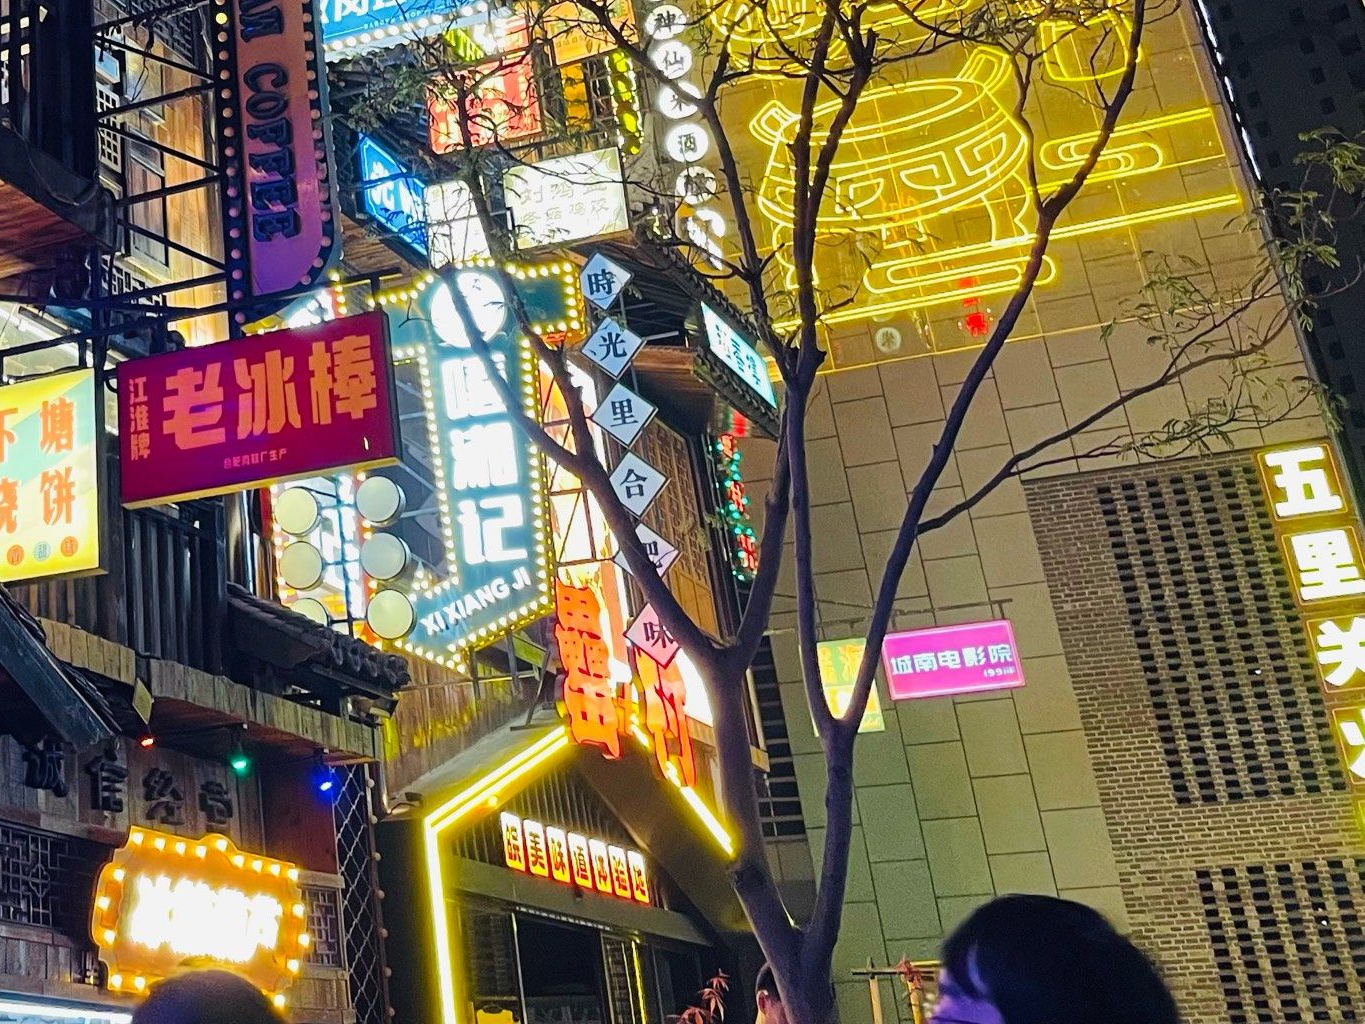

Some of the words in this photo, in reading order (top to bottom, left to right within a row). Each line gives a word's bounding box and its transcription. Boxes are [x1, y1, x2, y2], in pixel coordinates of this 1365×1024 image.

[241, 63, 302, 243] COFFEE
[128, 376, 151, 461] 江淮牌
[162, 334, 378, 451] 老冰棒
[420, 608, 444, 636] XI
[441, 573, 510, 626] XIANG
[510, 565, 532, 600] JI
[890, 643, 1013, 676] 城南电影院
